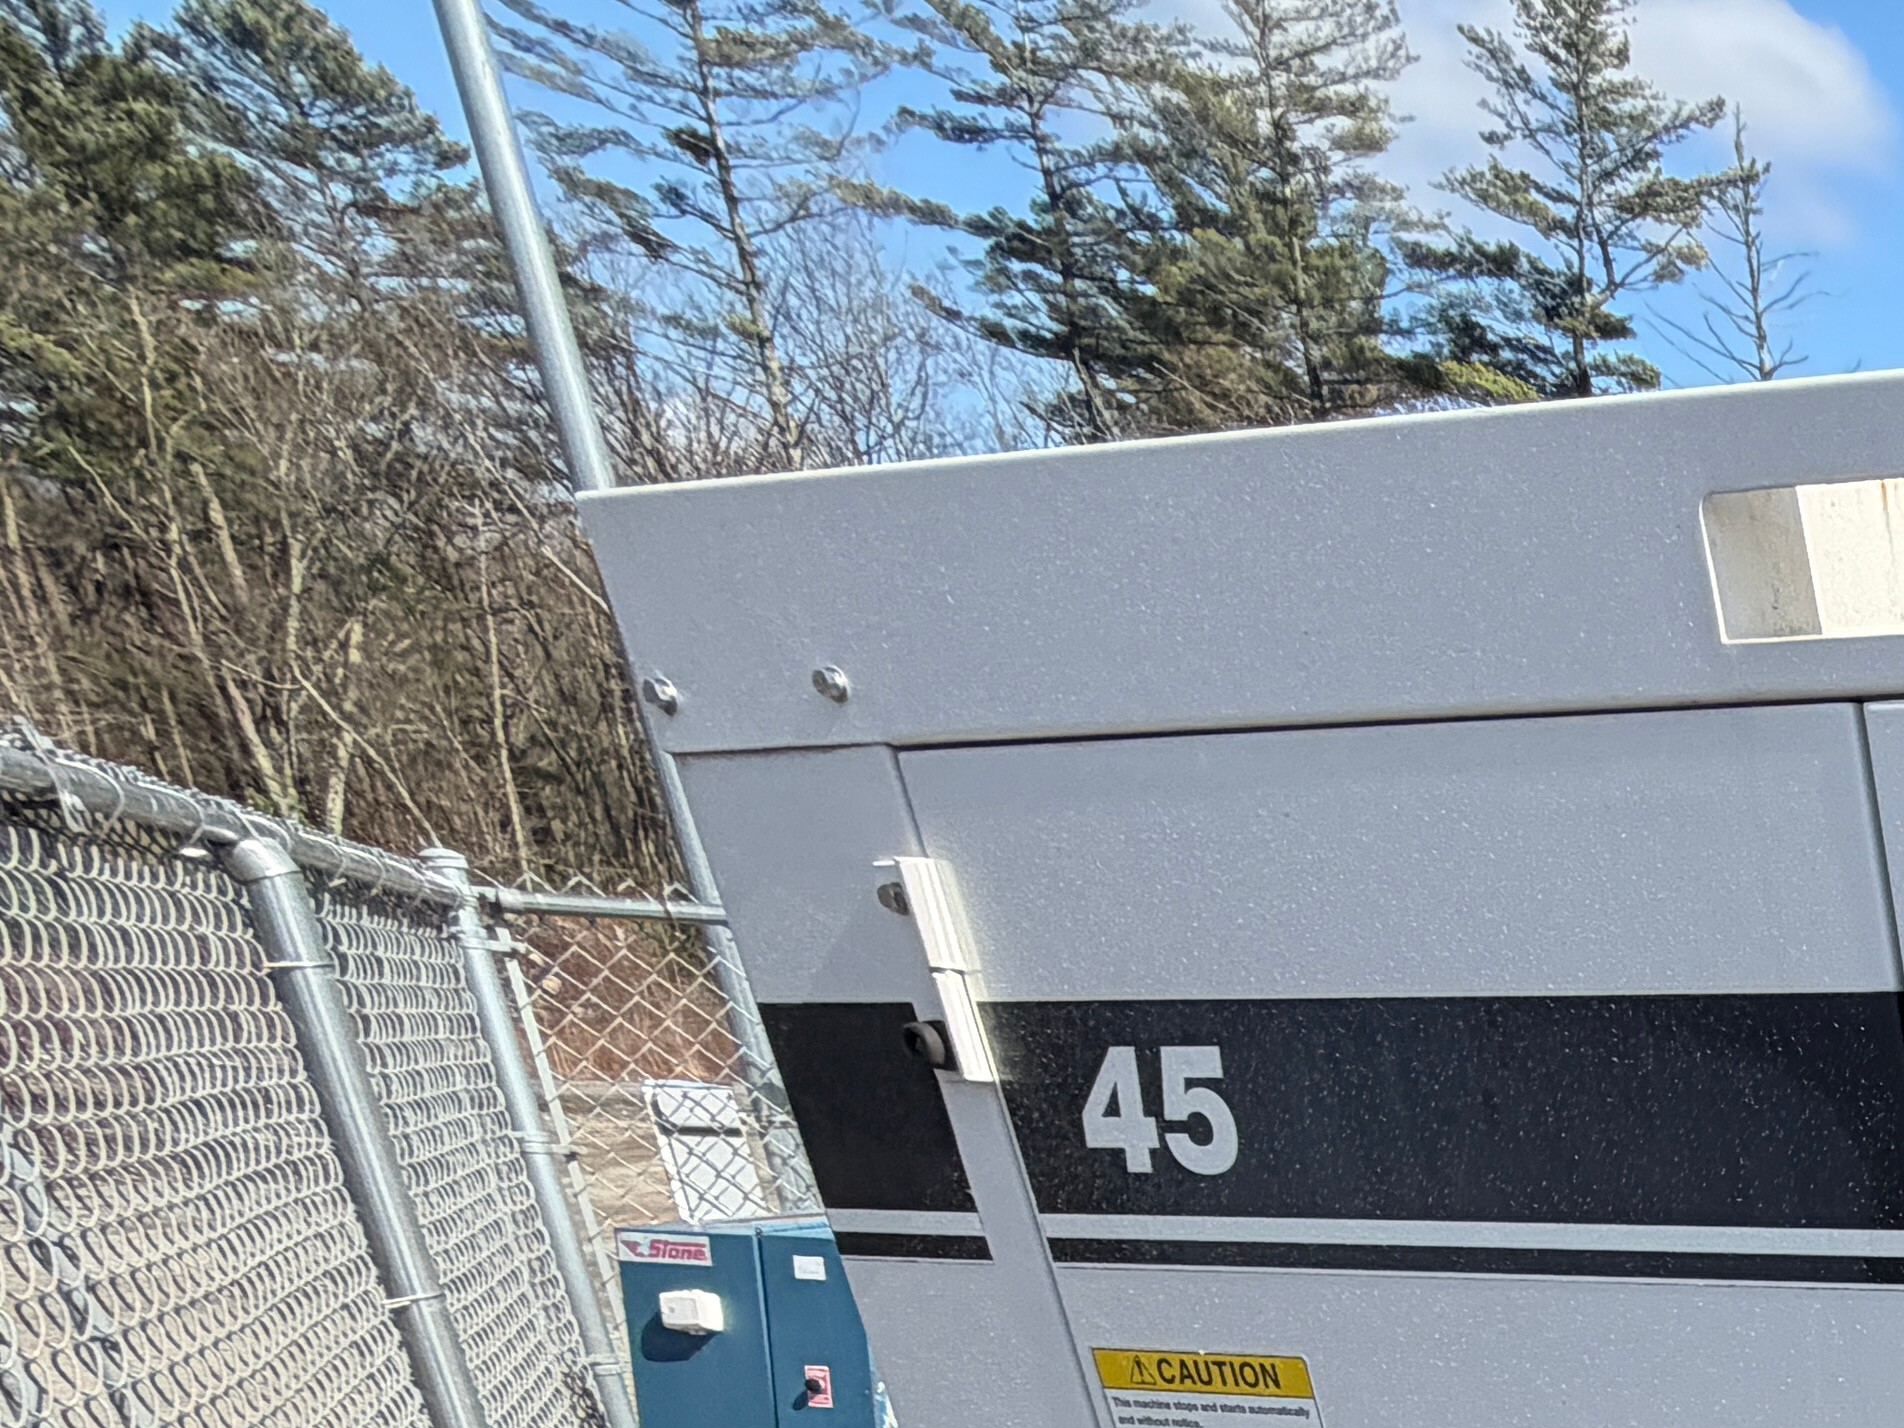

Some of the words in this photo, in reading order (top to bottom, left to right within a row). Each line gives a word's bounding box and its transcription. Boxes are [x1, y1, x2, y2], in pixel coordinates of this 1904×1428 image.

[1082, 1045, 1239, 1176] 45
[1156, 1357, 1282, 1390] CAUTION
[1112, 1396, 1132, 1409] This
[1133, 1398, 1171, 1412] machine
[1200, 1402, 1218, 1413] and
[1118, 1416, 1136, 1426] and
[1136, 1416, 1170, 1428] without
